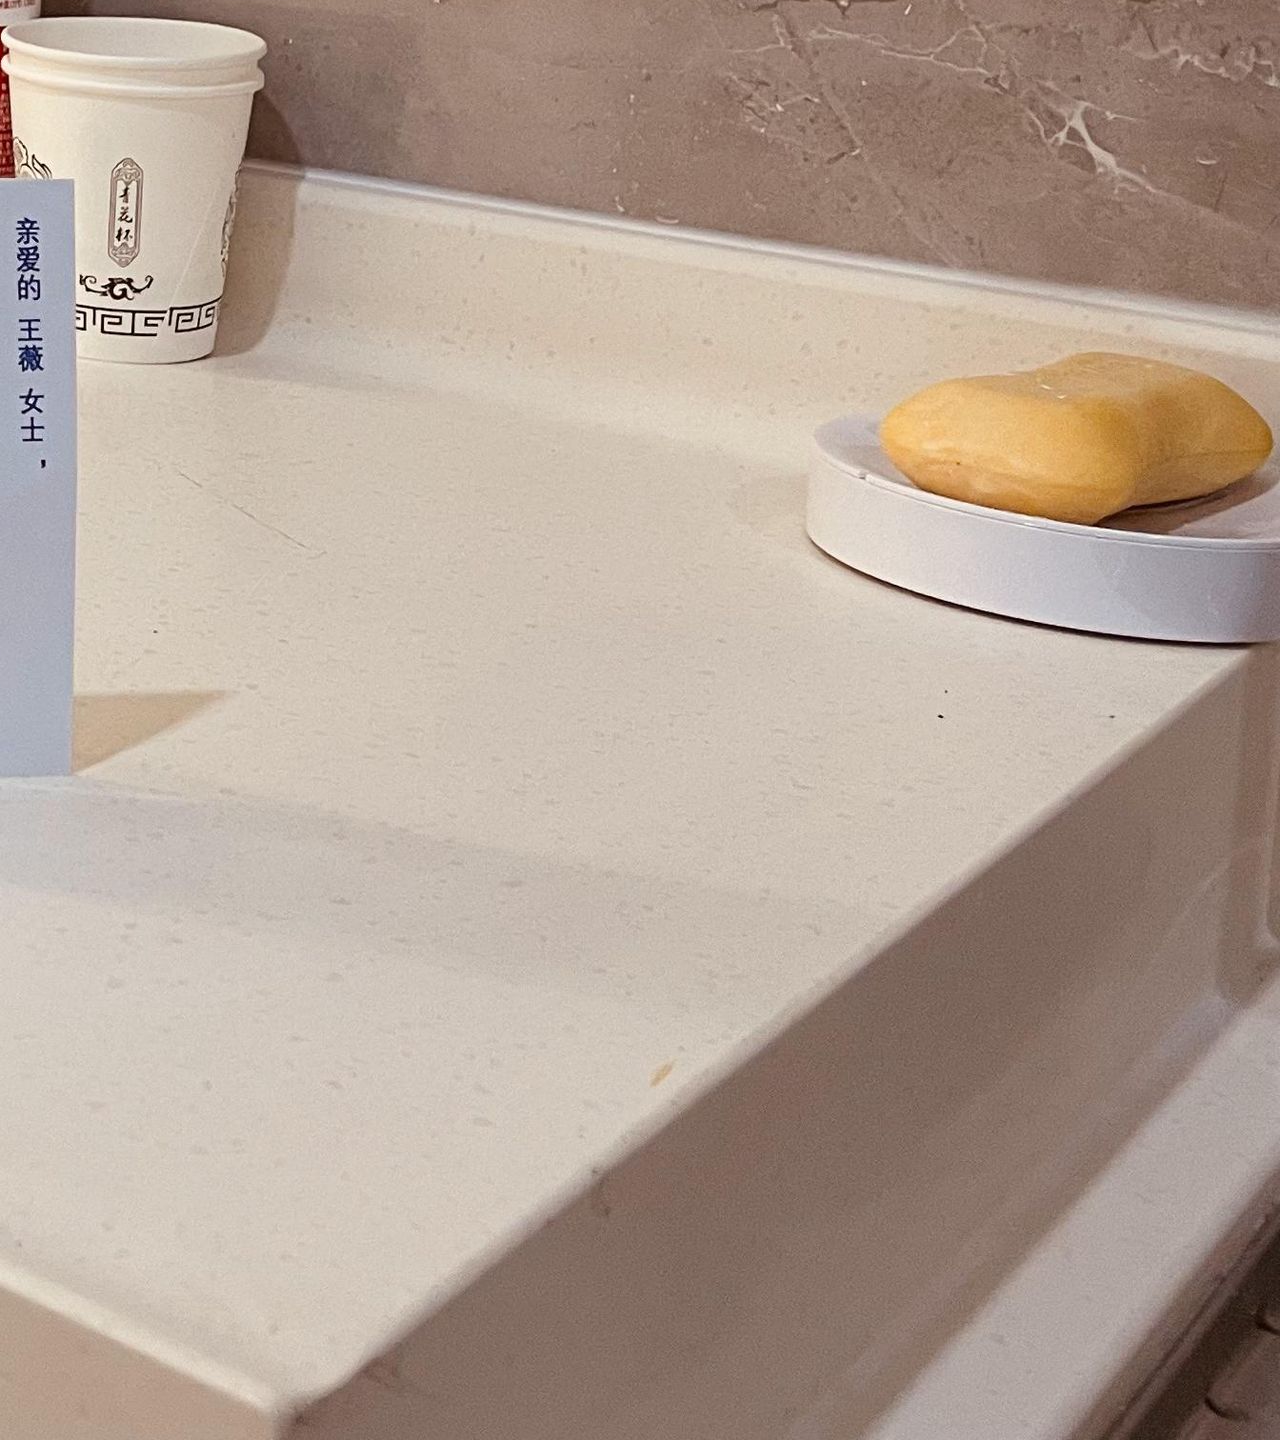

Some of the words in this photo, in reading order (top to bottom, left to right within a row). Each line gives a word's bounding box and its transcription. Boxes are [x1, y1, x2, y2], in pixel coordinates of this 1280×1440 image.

[15, 216, 42, 301] 亲爱的
[17, 318, 45, 373] 王薇
